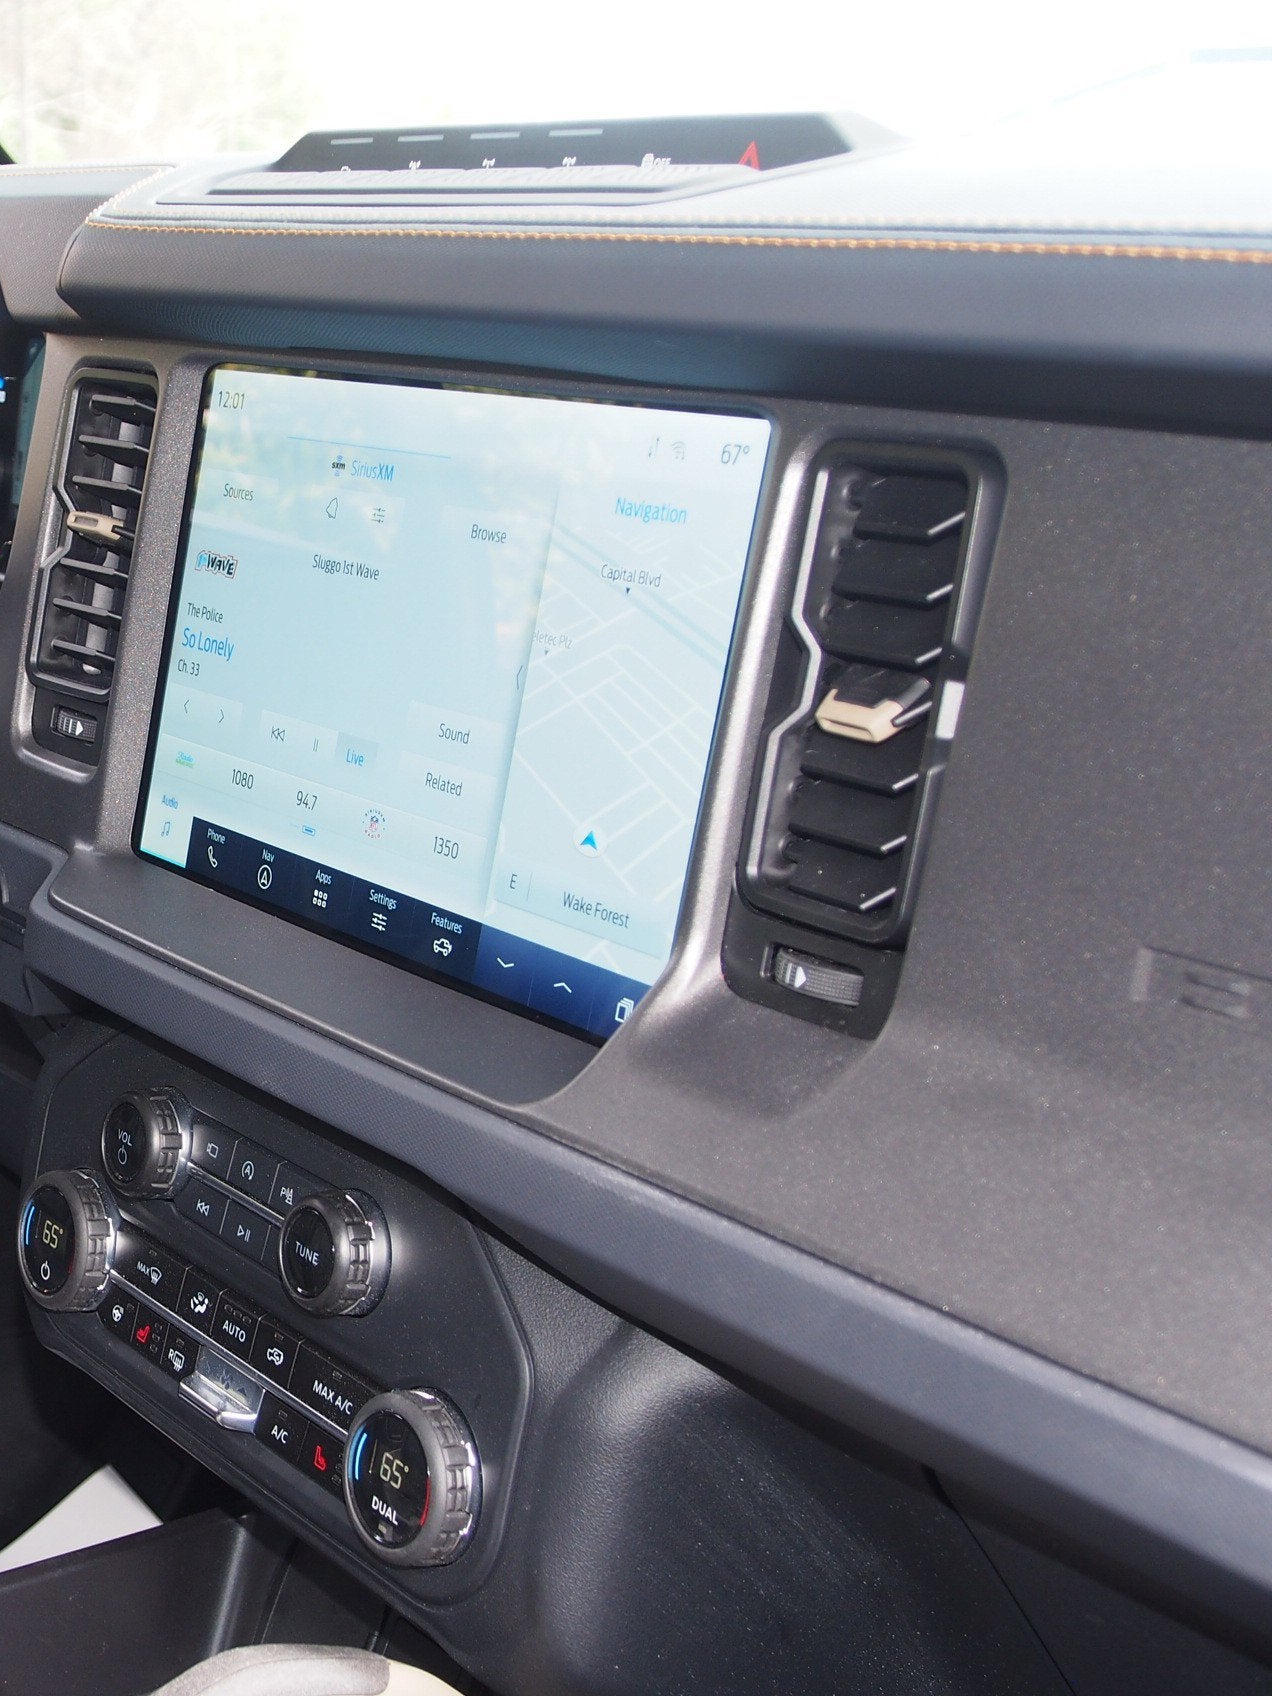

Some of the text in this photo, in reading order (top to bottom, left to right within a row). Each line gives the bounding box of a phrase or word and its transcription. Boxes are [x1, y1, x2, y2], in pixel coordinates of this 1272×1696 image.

[218, 390, 245, 410] 12:01
[721, 443, 751, 465] 67°
[351, 460, 395, 481] SiriusXM
[223, 483, 254, 501] Sources
[614, 497, 688, 524] Navigation
[470, 524, 507, 544] Browse
[312, 554, 341, 574] Sluggo
[356, 564, 380, 580] Wave
[600, 563, 662, 588] Capital Blvd
[187, 602, 224, 624] The Police
[182, 627, 235, 661] So Lonely
[178, 659, 200, 677] Ch. 33
[439, 723, 470, 745] Sound
[346, 748, 364, 767] Live
[231, 769, 254, 789] 1080
[425, 772, 463, 797] Related
[161, 794, 179, 810] Audio
[296, 790, 317, 810] 94.7
[206, 828, 226, 845] Phone
[261, 849, 275, 862] Nav
[433, 836, 459, 860] 1350
[315, 869, 332, 885] Apps
[509, 873, 518, 890] E
[369, 889, 397, 910] Settings
[562, 890, 629, 929] Wake Forest
[431, 912, 463, 935] Features
[117, 1128, 133, 1147] VOL
[295, 1241, 320, 1266] TUNE
[136, 1261, 150, 1276] MAX
[222, 1320, 246, 1343] AUTO
[312, 1379, 354, 1415] MAX A/C
[270, 1424, 289, 1444] A/C
[371, 1495, 399, 1526] DUAL
